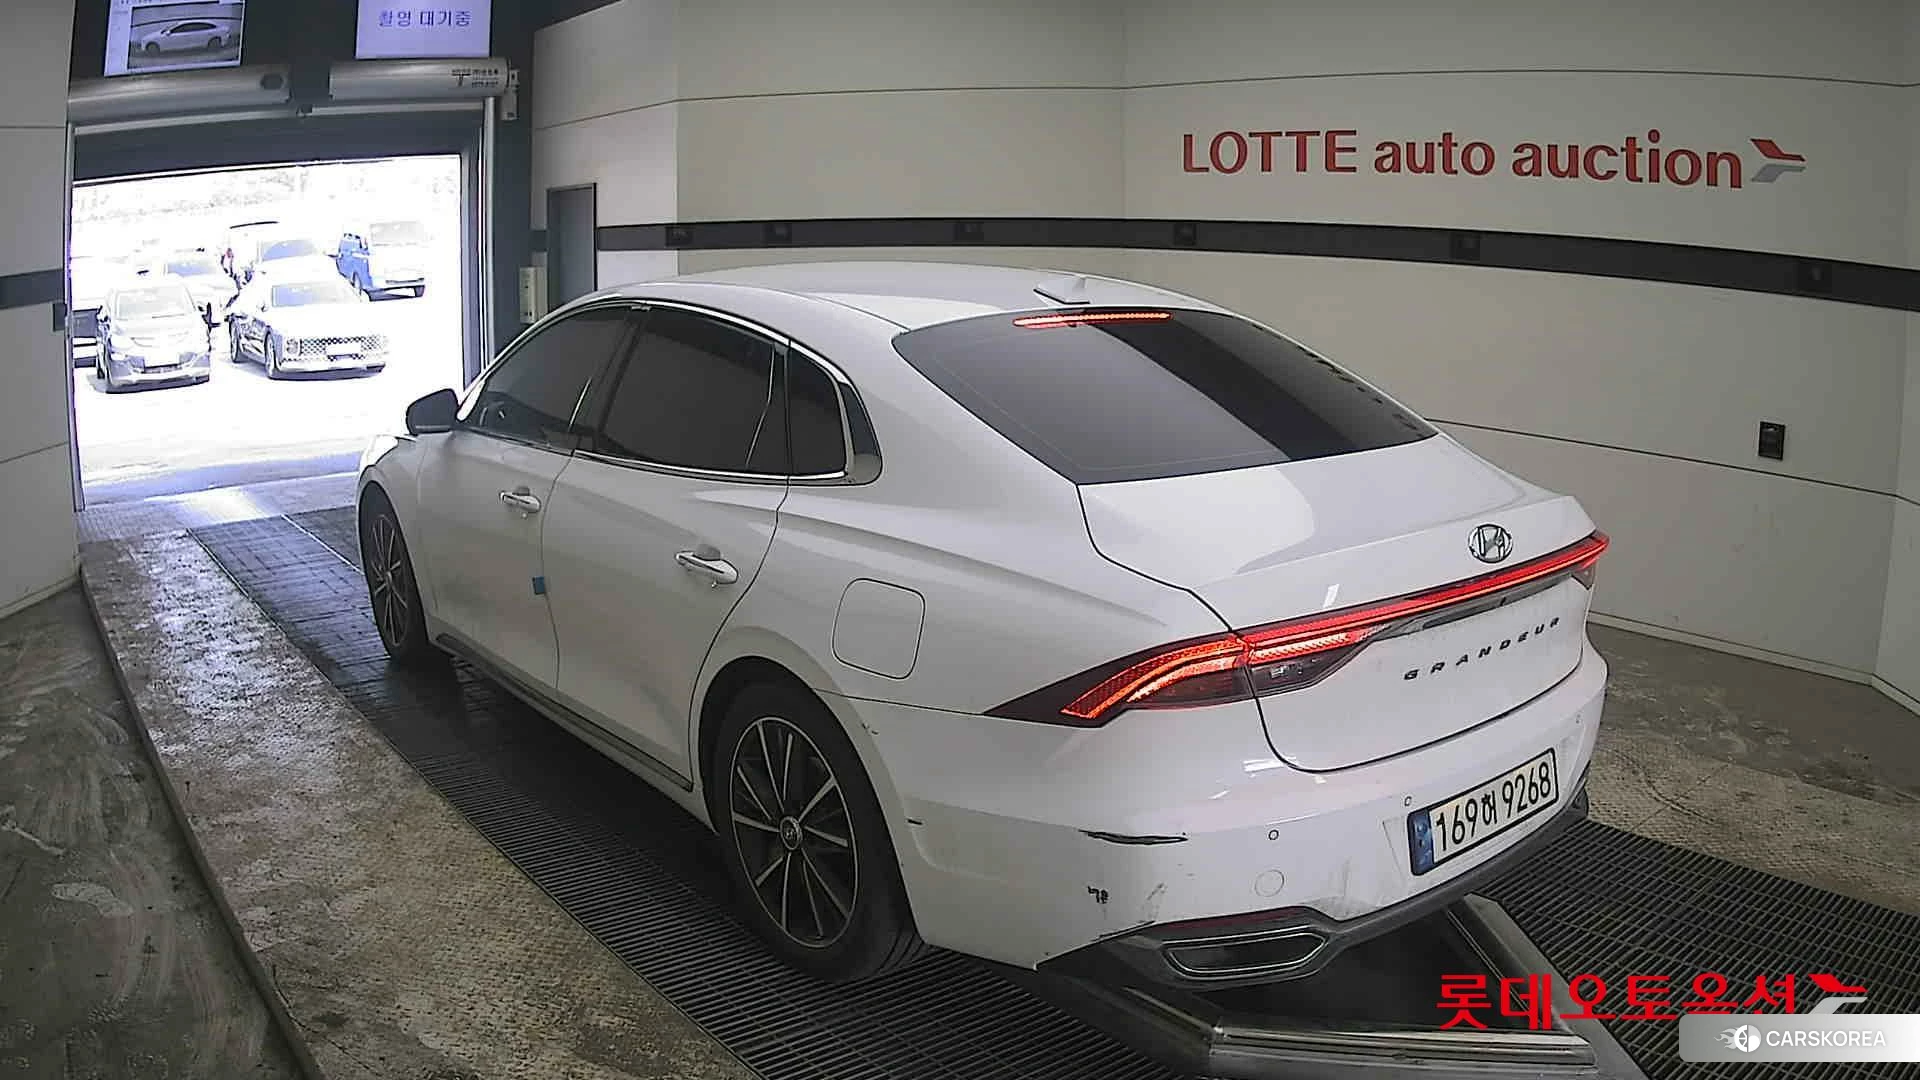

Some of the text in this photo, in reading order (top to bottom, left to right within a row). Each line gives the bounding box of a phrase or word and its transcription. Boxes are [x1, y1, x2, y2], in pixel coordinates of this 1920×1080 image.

[420, 10, 472, 27] 대기중
[1183, 129, 1743, 189] LOTTE auto auction
[1404, 617, 1560, 681] GRANDEUR
[1502, 761, 1552, 819] 9268
